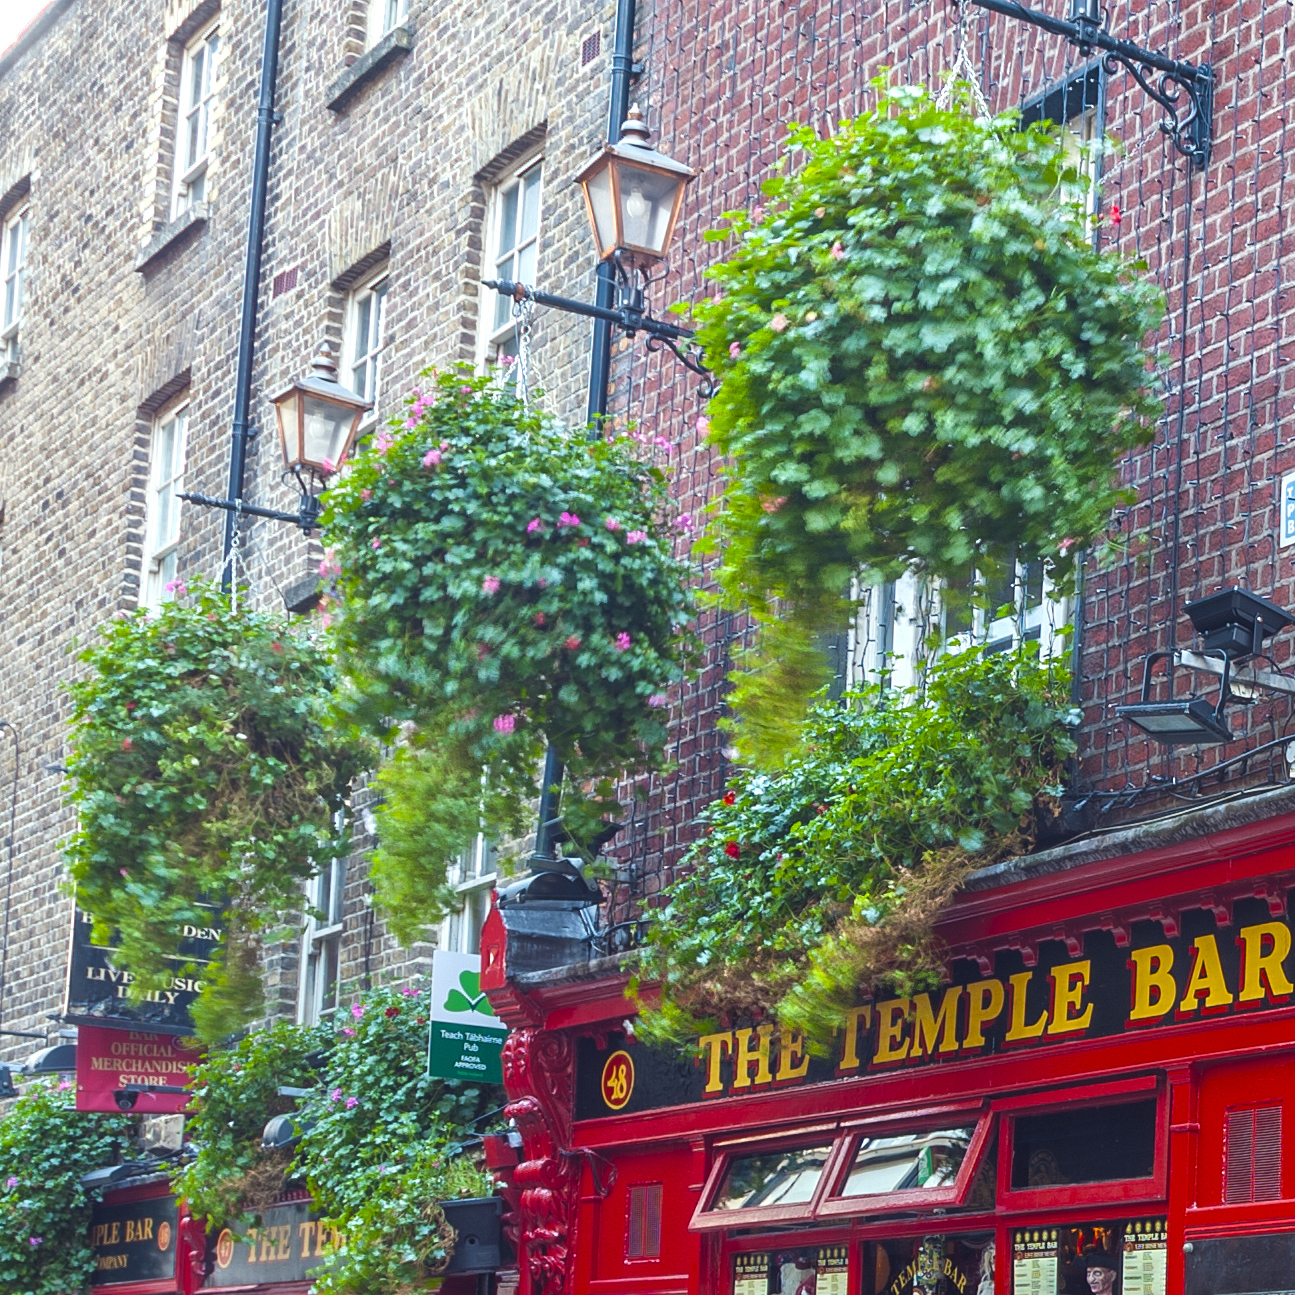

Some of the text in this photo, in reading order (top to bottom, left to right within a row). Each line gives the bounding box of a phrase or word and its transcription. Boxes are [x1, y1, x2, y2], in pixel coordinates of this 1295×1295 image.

[86, 967, 137, 984] LIVE
[698, 919, 1295, 1096] THE TEMPLE BAR
[110, 1042, 177, 1058] OFFICIAL
[463, 1042, 479, 1052] Pub
[117, 1074, 169, 1088] STORE
[606, 1061, 629, 1101] 48
[125, 1217, 154, 1243] BAR
[247, 1224, 292, 1264] THE
[943, 1258, 968, 1294] BAR
